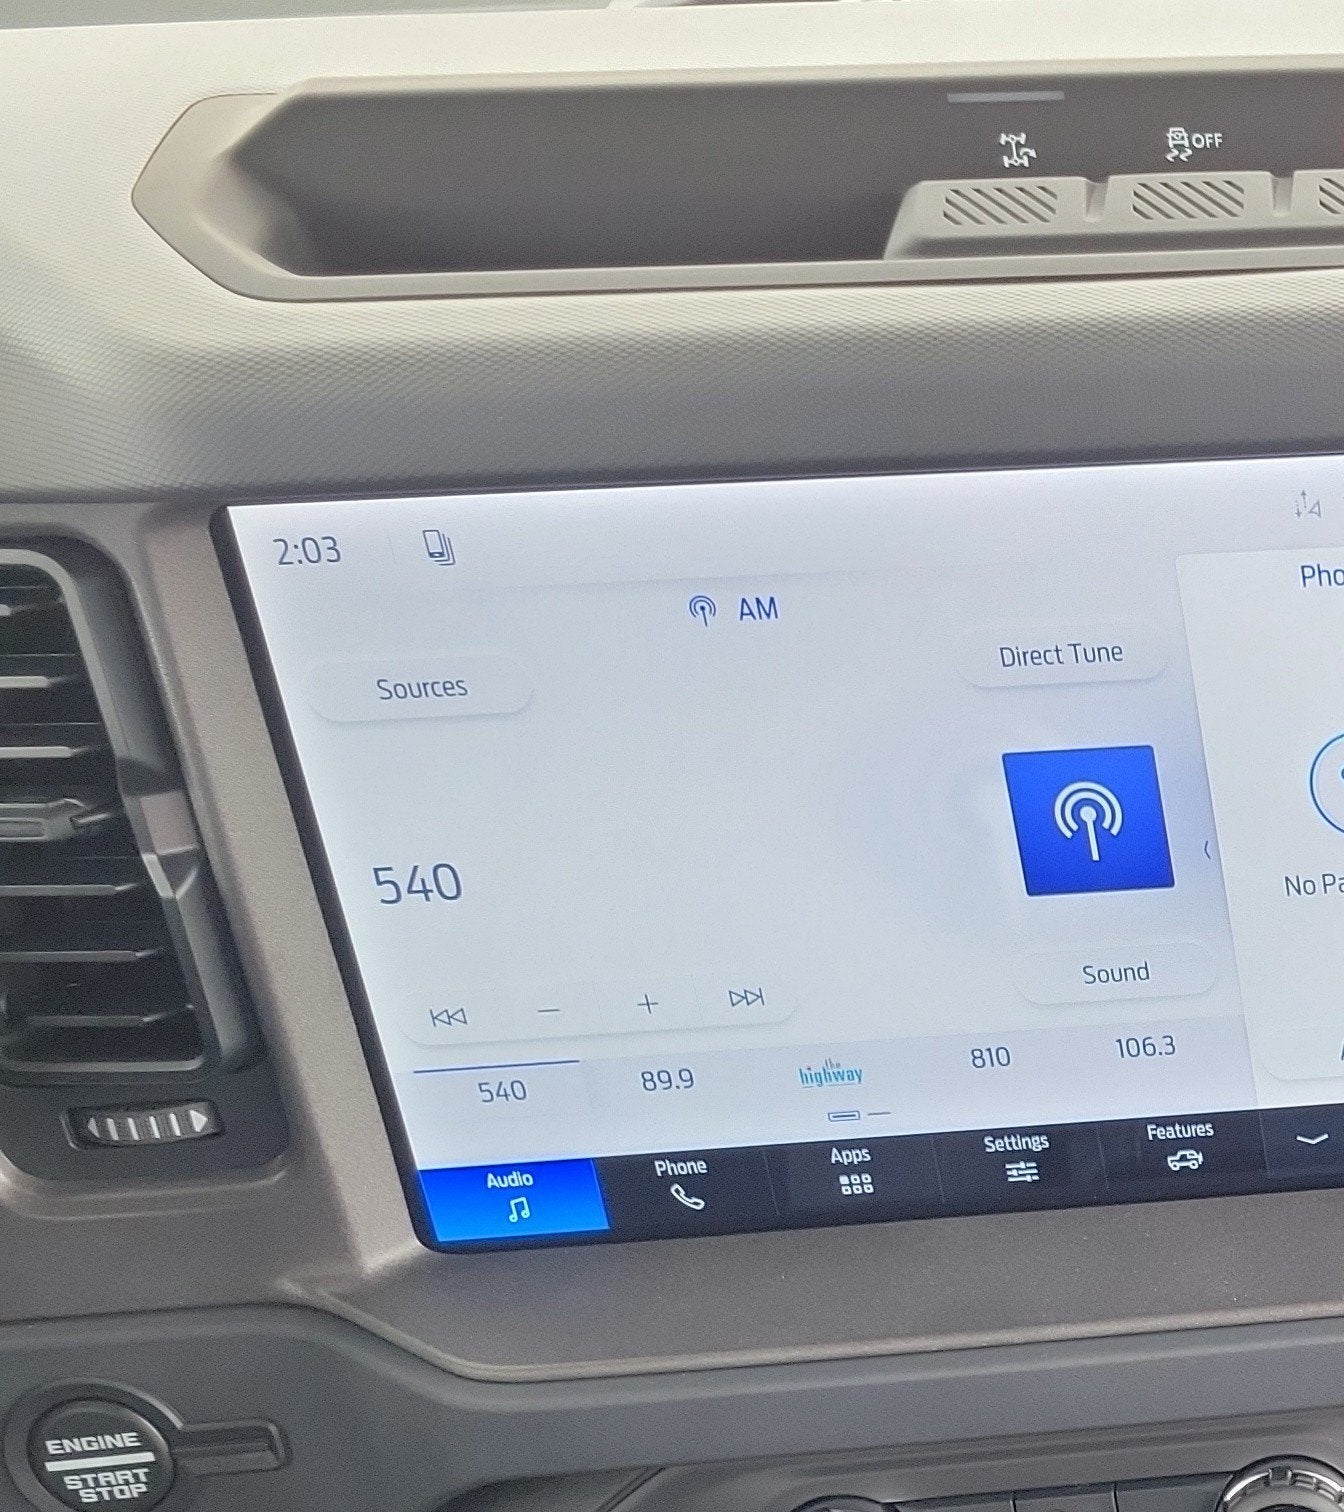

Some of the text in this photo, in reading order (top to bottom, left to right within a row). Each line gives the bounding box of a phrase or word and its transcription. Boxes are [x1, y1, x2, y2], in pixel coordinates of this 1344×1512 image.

[1192, 132, 1223, 149] OFF
[273, 536, 342, 567] 2:03
[738, 596, 779, 622] AM
[998, 641, 1124, 668] Direct Tune
[375, 673, 469, 702] Sources
[371, 861, 464, 908] 540
[1284, 873, 1317, 898] No
[1082, 960, 1151, 986] Sound
[970, 1045, 1012, 1070] 810
[1115, 1034, 1177, 1060] 106.3
[640, 1066, 695, 1094] 89.9
[798, 1065, 863, 1088] highway
[477, 1077, 528, 1105] 540
[982, 1130, 1050, 1156] Settings
[1146, 1120, 1215, 1144] Features
[653, 1155, 708, 1178] Phone
[829, 1144, 872, 1168] Apps
[486, 1168, 534, 1190] Audio
[44, 1431, 144, 1455] ENGINE
[62, 1467, 151, 1491] START
[78, 1483, 149, 1504] STOP
